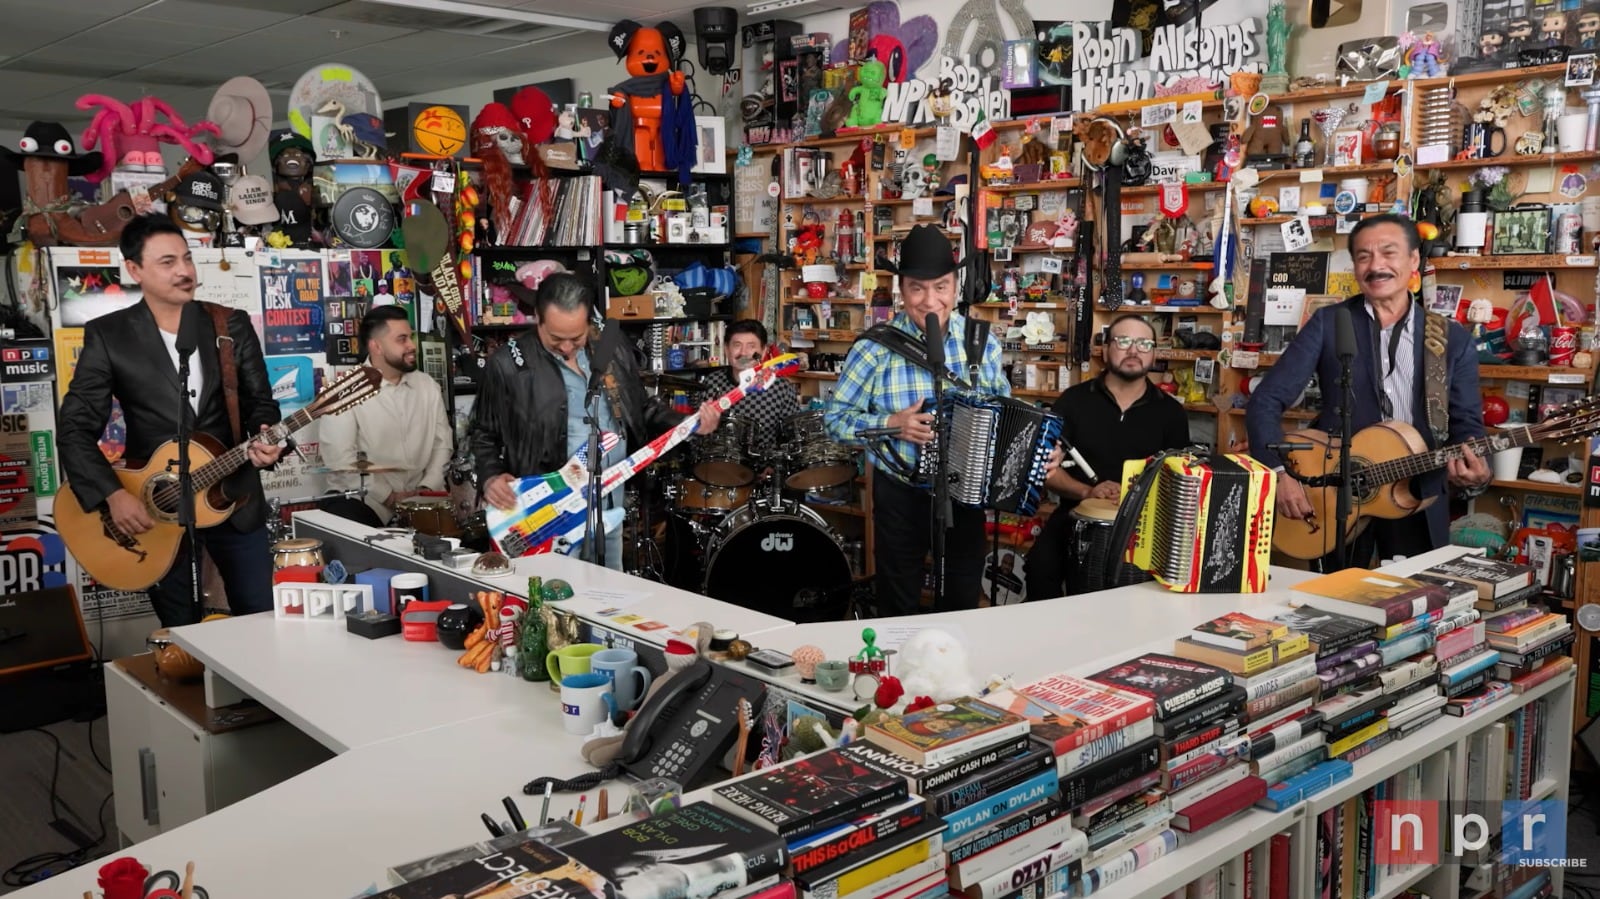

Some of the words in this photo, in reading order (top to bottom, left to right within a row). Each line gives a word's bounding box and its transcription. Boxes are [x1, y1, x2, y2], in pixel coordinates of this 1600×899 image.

[1073, 21, 1136, 71] Robin
[1150, 17, 1256, 72] Allsongs
[940, 53, 980, 92] Bob
[1073, 64, 1150, 112] Hilton
[881, 80, 939, 124] NPR
[950, 76, 1012, 129] Boilen
[296, 279, 307, 290] ON
[308, 278, 320, 289] THE
[1272, 273, 1289, 283] GOD
[265, 293, 292, 309] DESK
[300, 290, 319, 302] ROAD
[441, 287, 458, 314] MAGIC
[266, 309, 310, 326] CONTEST
[6, 347, 45, 360] npr
[6, 361, 49, 375] music
[41, 462, 52, 493] EDITION
[761, 533, 794, 551] dw
[1164, 687, 1196, 710] QUEENS
[1202, 676, 1225, 694] NOISE
[1180, 734, 1200, 752] HARD
[1200, 727, 1221, 744] STUFF
[848, 744, 929, 777] JOHNNY
[925, 767, 959, 790] JOHNNY
[960, 758, 981, 775] CASH
[981, 751, 998, 766] FAQ
[718, 786, 751, 805] HERE
[951, 781, 982, 800] DREAM
[681, 809, 729, 833] MARCUS
[749, 800, 791, 824] BEING
[952, 808, 991, 834] DYLAN
[992, 801, 1008, 816] ON
[1009, 784, 1046, 807] DYLAN
[621, 828, 650, 844] BOB
[636, 823, 680, 845] DYLAN
[650, 820, 672, 829] BY
[792, 846, 826, 872] THIS
[827, 844, 838, 858] is
[838, 841, 849, 854] a
[849, 825, 876, 849] CALL
[952, 851, 962, 861] THE
[962, 847, 972, 858] DAY
[972, 832, 1004, 854] ALTERNATIVE
[1004, 825, 1018, 840] MUSIC
[1018, 820, 1031, 834] DIED
[1011, 854, 1053, 889] OZZY
